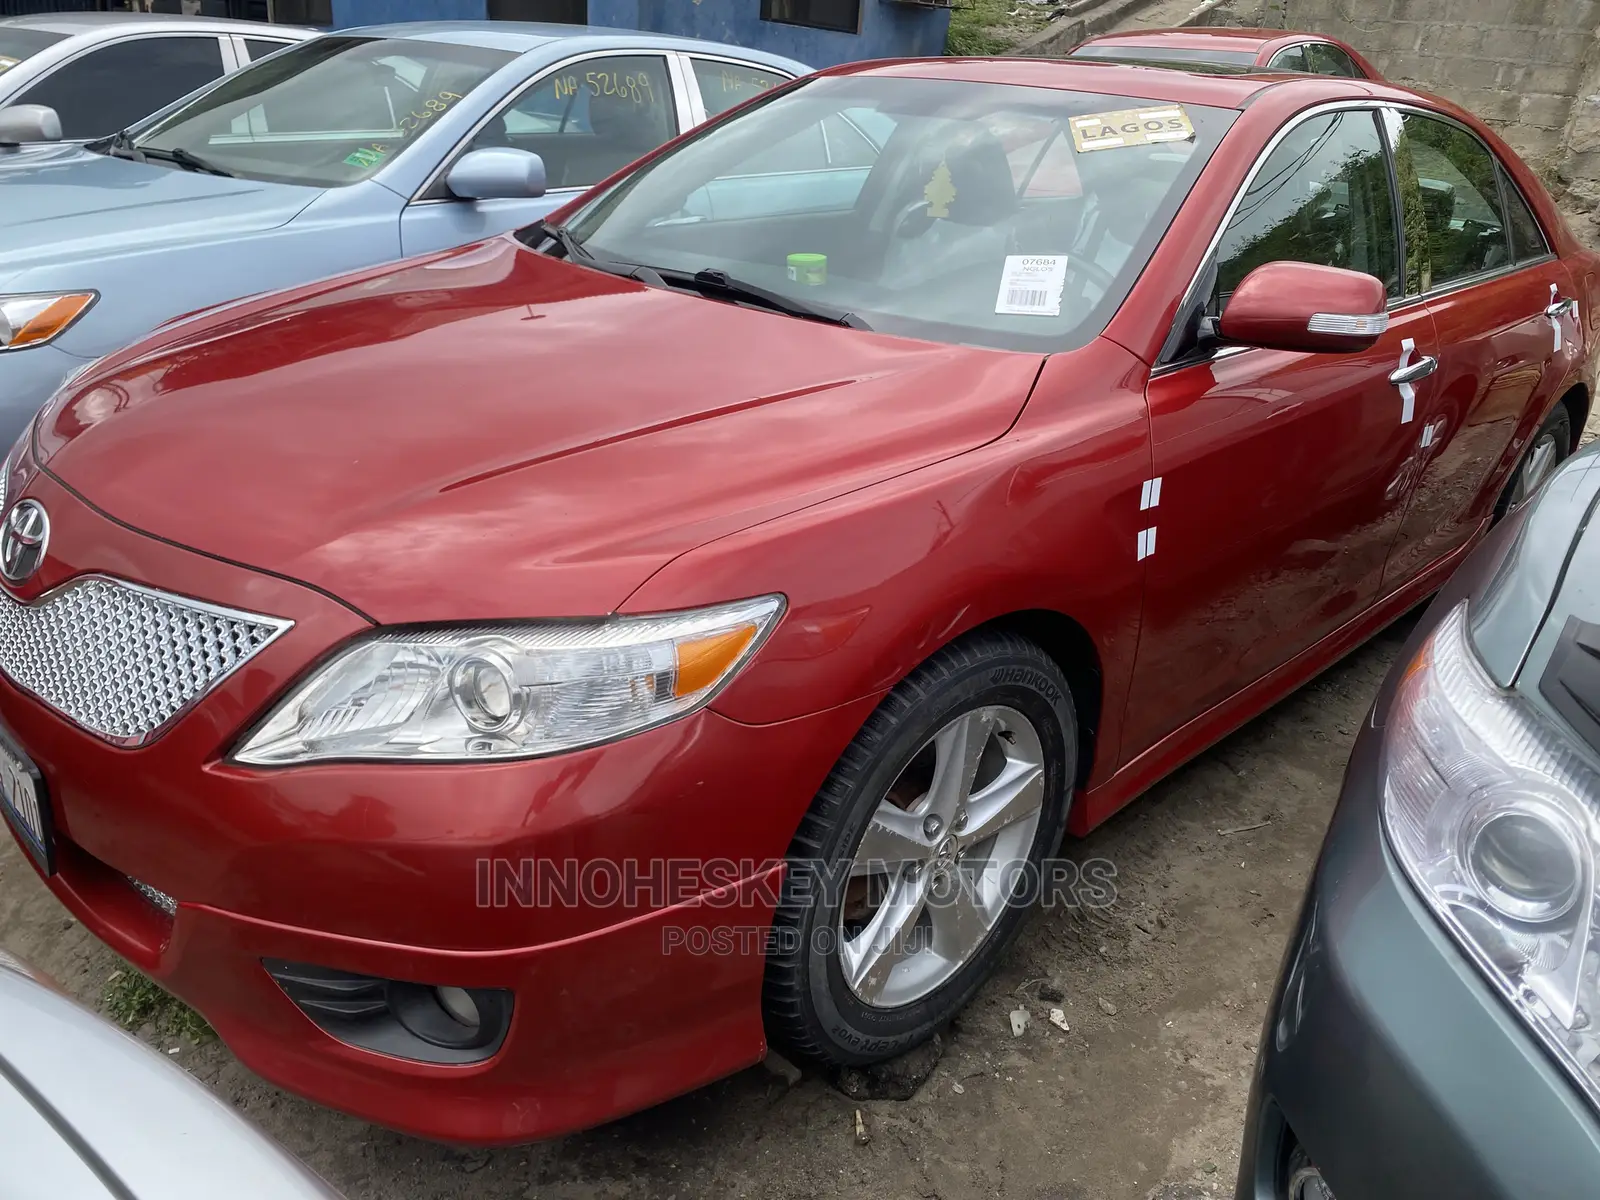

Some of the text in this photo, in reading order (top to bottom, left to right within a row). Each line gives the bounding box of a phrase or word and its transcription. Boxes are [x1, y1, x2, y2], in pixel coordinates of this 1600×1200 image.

[586, 72, 655, 104] 52689
[398, 91, 463, 137] 2689
[1081, 118, 1183, 140] LAGOS
[1022, 258, 1056, 266] 07684
